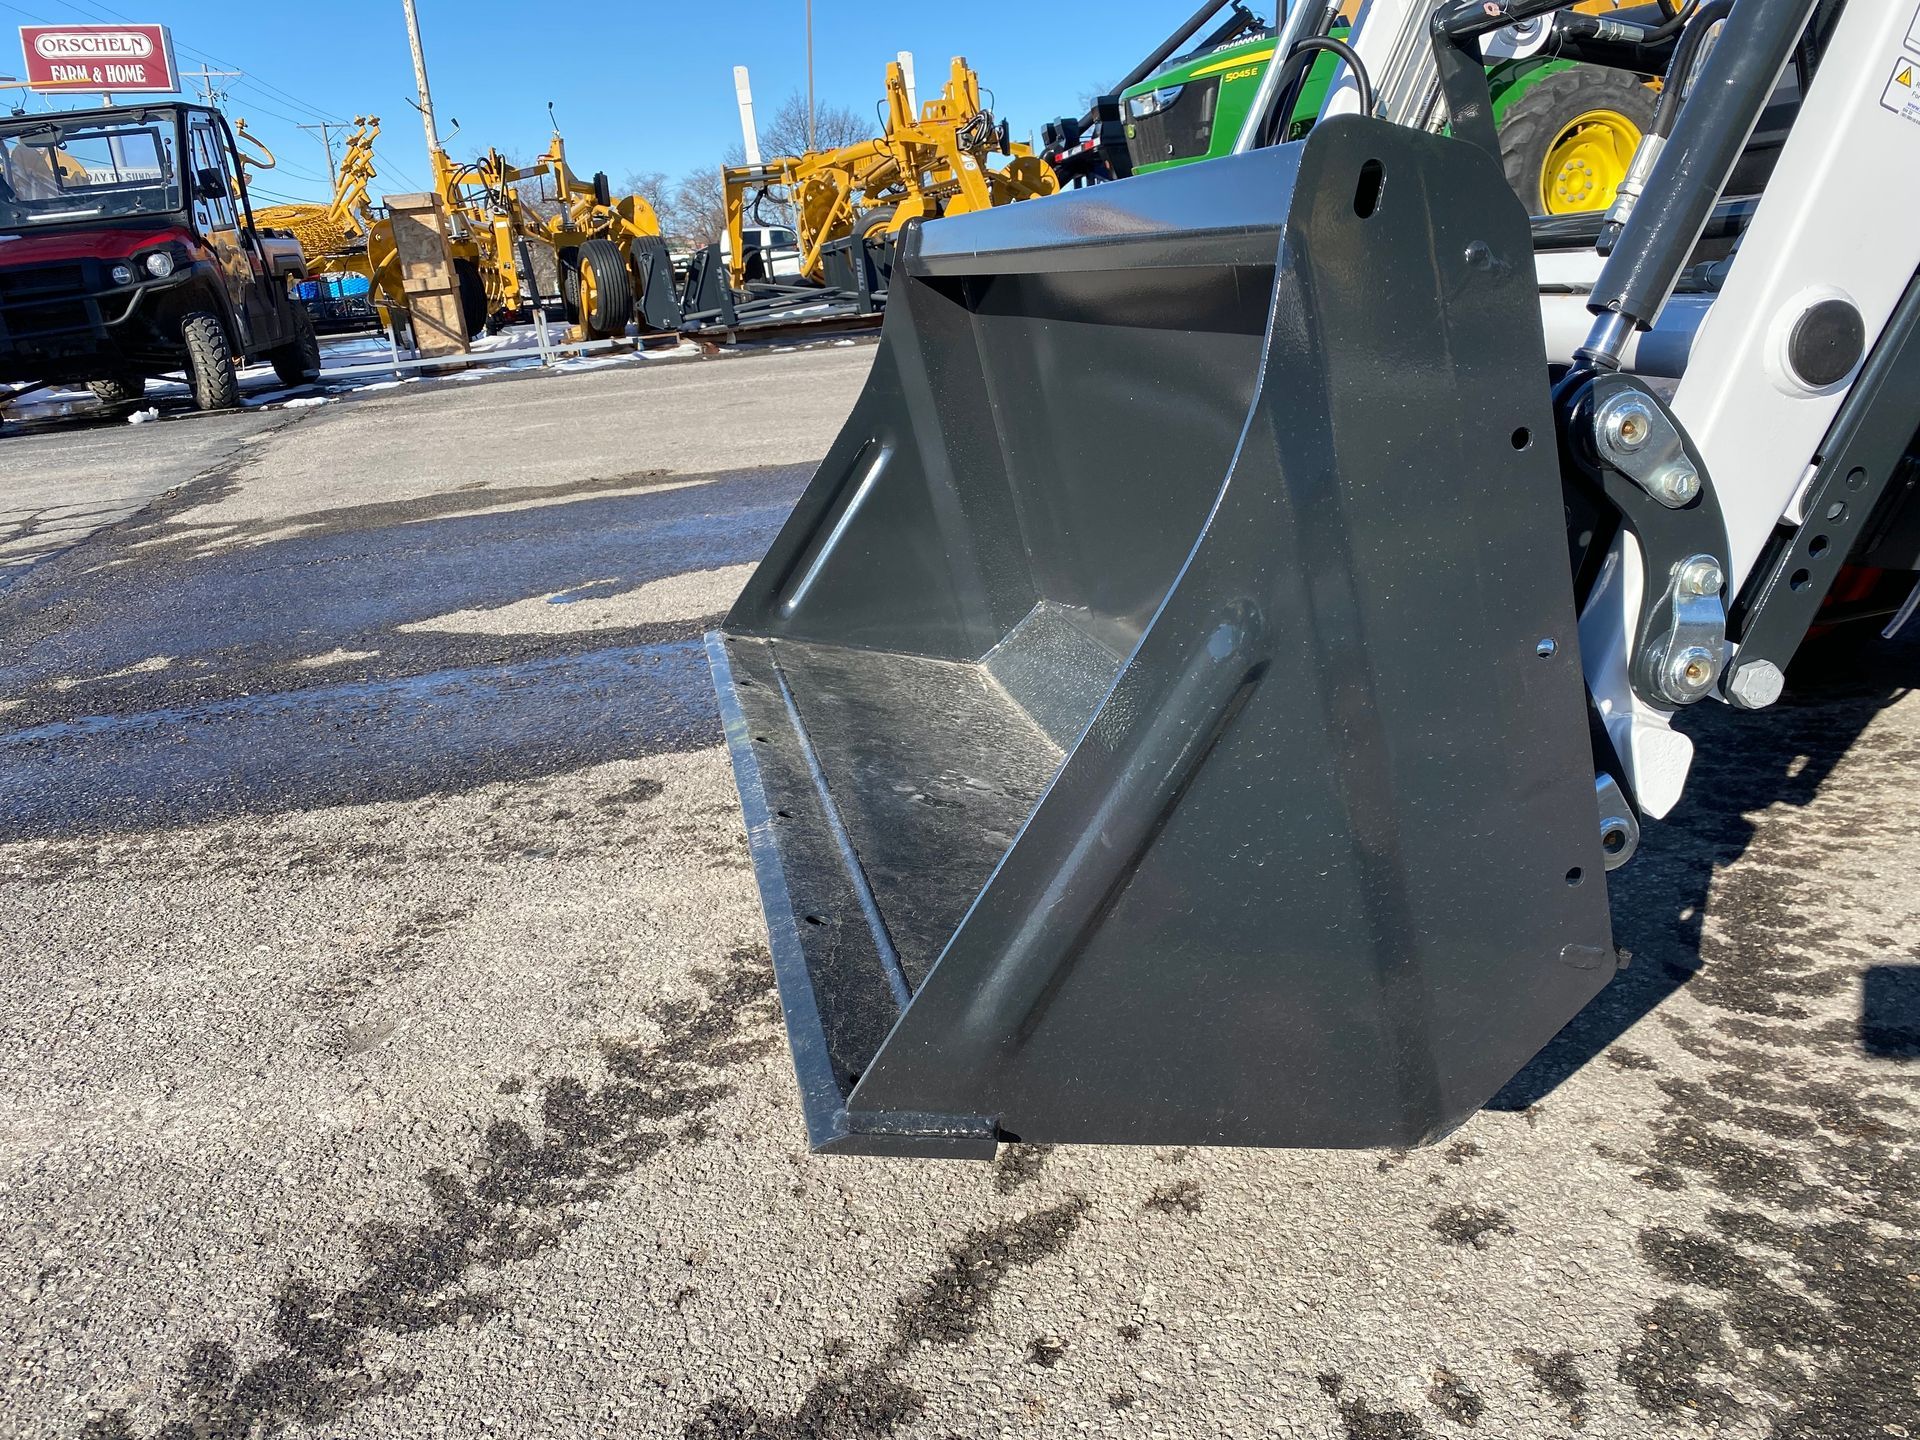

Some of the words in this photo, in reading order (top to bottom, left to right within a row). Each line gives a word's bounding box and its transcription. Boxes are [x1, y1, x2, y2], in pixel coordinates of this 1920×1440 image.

[42, 38, 144, 55] ORSCHELN
[50, 64, 89, 81] FARM
[92, 66, 103, 83] &
[105, 64, 146, 83] HOME
